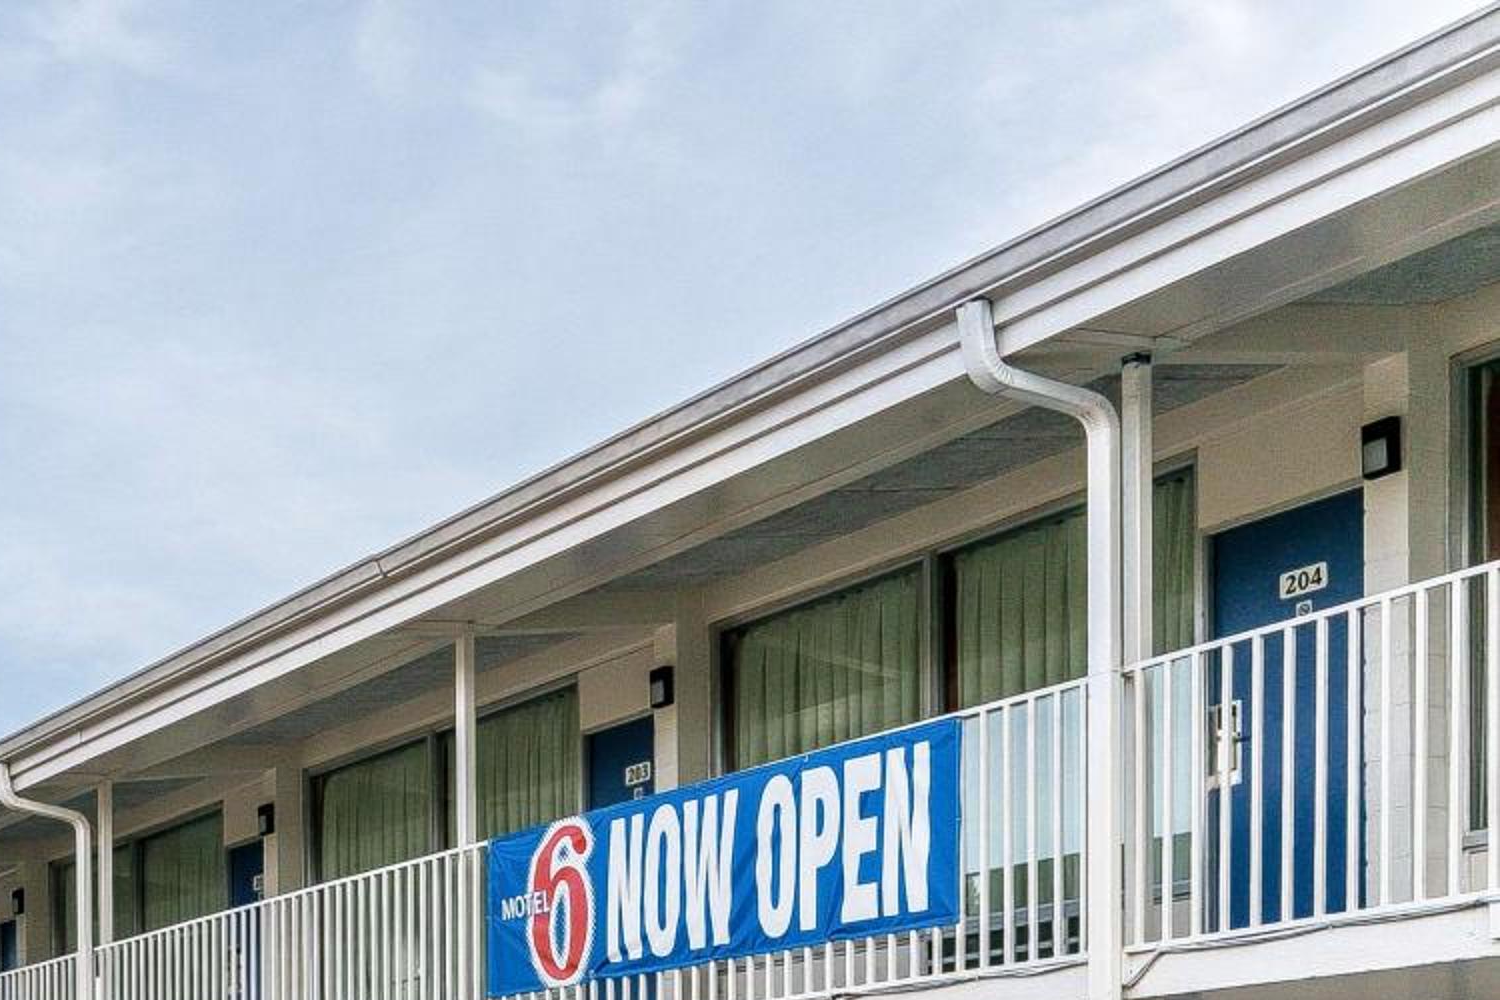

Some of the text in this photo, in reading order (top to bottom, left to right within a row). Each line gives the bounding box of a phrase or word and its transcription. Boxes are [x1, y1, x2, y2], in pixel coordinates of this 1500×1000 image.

[1285, 566, 1323, 595] 204
[501, 816, 598, 988] MOTEL 6
[607, 741, 931, 963] NOW OPEN
